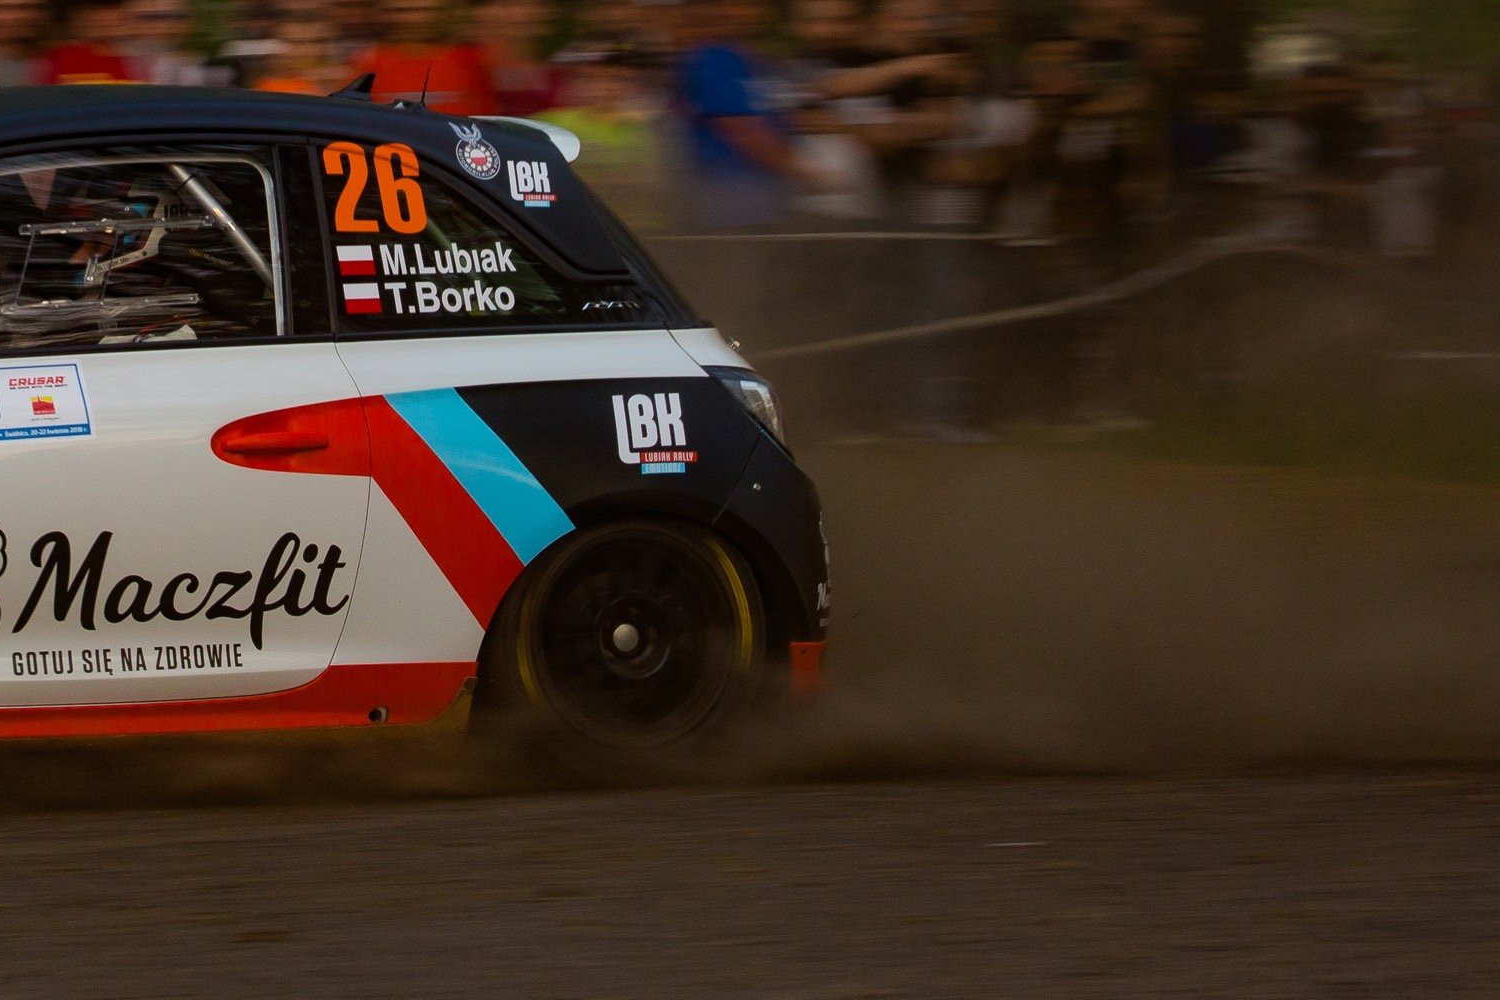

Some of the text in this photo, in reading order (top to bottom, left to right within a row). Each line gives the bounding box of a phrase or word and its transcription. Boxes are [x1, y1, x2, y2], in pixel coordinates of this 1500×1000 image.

[323, 141, 428, 235] 26
[507, 160, 551, 201] LBK
[384, 280, 515, 314] T.Borko
[9, 376, 64, 387] CRUSAR
[612, 392, 687, 464] LBK
[12, 530, 350, 650] Maczfit
[12, 643, 244, 676] GOTUJ SIĘ NA ZDROWIE
